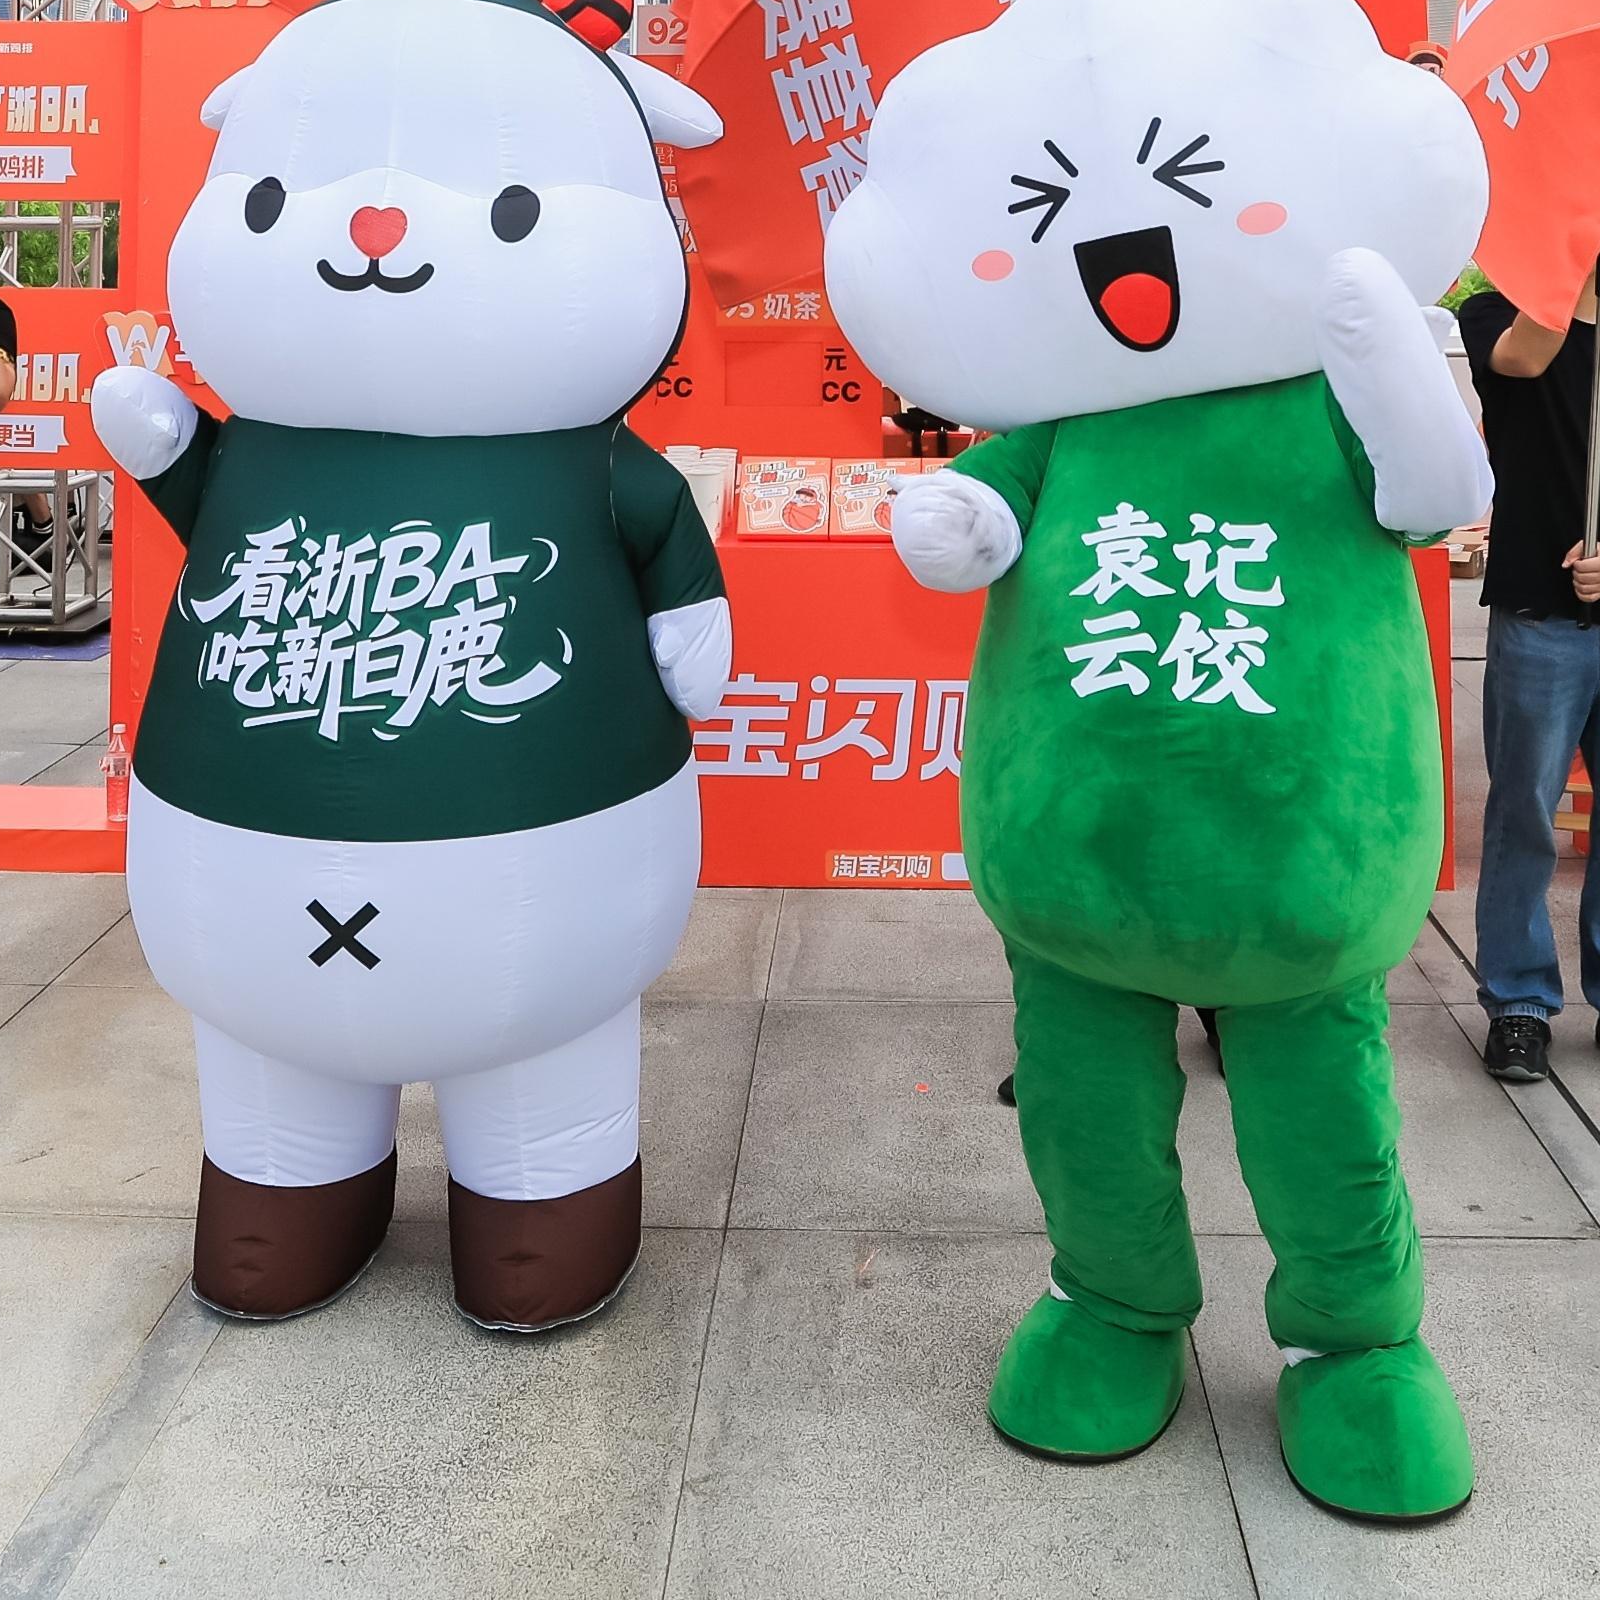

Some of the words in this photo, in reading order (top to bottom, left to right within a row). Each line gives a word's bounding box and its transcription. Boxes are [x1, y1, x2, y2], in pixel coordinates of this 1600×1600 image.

[648, 16, 687, 45] 92
[763, 292, 822, 321] 奶茶
[824, 348, 848, 371] 元
[656, 376, 693, 399] CC
[822, 380, 862, 403] CC
[1069, 501, 1285, 607] 袁记
[191, 518, 530, 625] 看浙BA
[205, 595, 563, 742] 吃新白鹿
[1064, 609, 1277, 715] 云饺
[832, 853, 932, 880] 淘宝闪购
